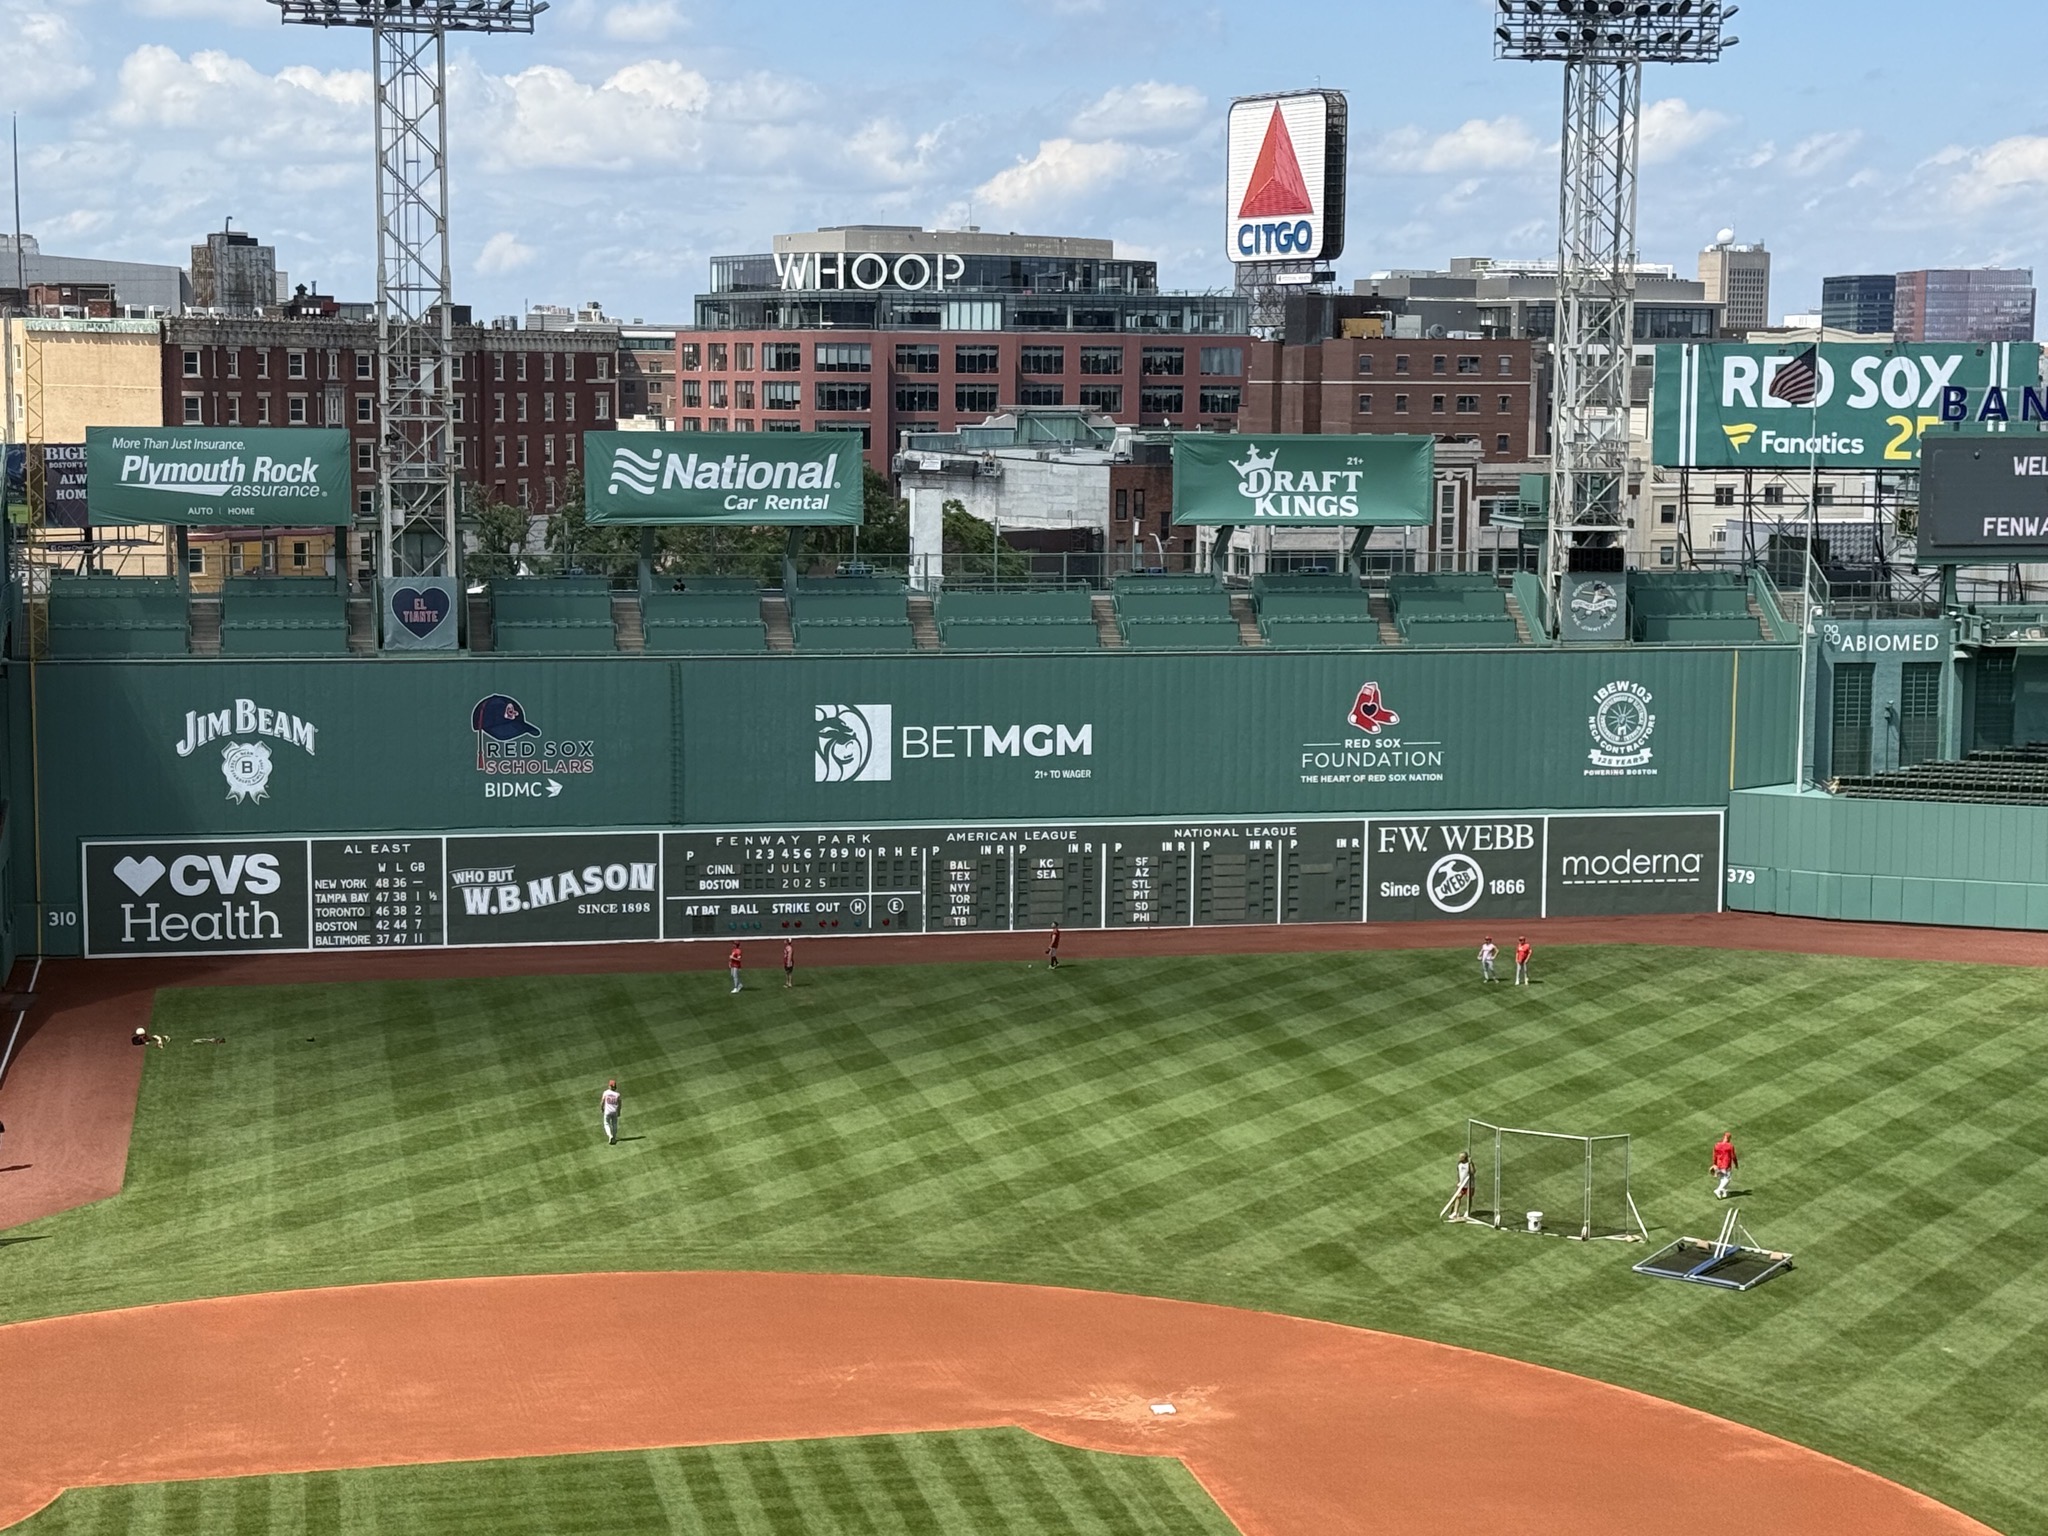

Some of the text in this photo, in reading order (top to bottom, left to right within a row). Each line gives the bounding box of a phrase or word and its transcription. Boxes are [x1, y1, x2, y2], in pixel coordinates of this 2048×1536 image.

[1238, 220, 1313, 255] CITGO
[773, 253, 965, 291] WHOOP
[1846, 355, 1963, 409] SOX
[112, 438, 246, 450] More Than Just Insurance.
[1761, 430, 1864, 455] Fanatics
[1346, 457, 1364, 465] 21+
[121, 455, 319, 485] Plymouth Rock
[662, 453, 838, 489] National
[1238, 469, 1363, 498] DRAFT
[231, 484, 320, 498] assurance
[723, 493, 829, 510] Car Rental
[1254, 493, 1359, 517] KINGS
[188, 507, 255, 516] AUTO HOME
[414, 598, 427, 610] EL
[403, 611, 439, 623] TIANTE
[1841, 634, 1939, 652] ABIOMED
[1593, 680, 1630, 704] IBEW
[1630, 683, 1653, 704] 103
[176, 698, 315, 757] JIM BEAM
[1600, 714, 1656, 754] CONTRACTORS
[902, 723, 1093, 759] BETMGM
[1344, 738, 1401, 748] RED SOX
[486, 740, 594, 758] RED SOX
[1302, 751, 1442, 768] FOUNDATION
[1615, 755, 1645, 765] YEARS
[241, 761, 253, 774] B
[486, 759, 594, 775] SCHOLARS
[1034, 769, 1092, 779] 21+ TO WAGER
[1300, 775, 1318, 783] THE
[1320, 775, 1351, 783] HEART
[1368, 774, 1386, 782] RED
[1388, 774, 1407, 782] SOX
[1409, 773, 1443, 781] NATION
[485, 782, 542, 797] BIDMC
[947, 831, 1077, 842] AMERICAN LEAGUE
[1174, 827, 1297, 838] NATIONAL LEAGUE
[1378, 824, 1534, 853] F.W. WEBB
[716, 834, 871, 846] FENWAY PARK
[344, 844, 411, 854] AL EAST
[932, 843, 1092, 856] P IN R P IN R
[1115, 842, 1185, 852] P IN R
[687, 847, 918, 861] P R H E
[378, 862, 425, 872] W L GB
[950, 860, 971, 870] BAL
[1039, 859, 1054, 868] KC
[1135, 857, 1149, 866] SF
[1562, 848, 1700, 876] moderna
[169, 853, 281, 896] CVS
[452, 869, 515, 884] WHO BUT
[950, 871, 971, 881] TEX
[1036, 870, 1057, 879] SEA
[1135, 868, 1149, 877] AZ
[1727, 869, 1755, 884] 379
[315, 878, 407, 889] NEW YORK 48 36
[700, 879, 740, 890] BOSTON
[950, 884, 971, 893] NYY
[1132, 880, 1151, 889] STL
[1380, 879, 1526, 897] Since 1866
[1440, 872, 1471, 895] WEBB
[315, 893, 347, 903] TAMPA
[351, 893, 369, 903] BAY
[376, 892, 390, 902] 47
[393, 892, 407, 901] 38
[950, 894, 971, 904] TOR
[1133, 891, 1150, 900] PIT
[315, 905, 422, 917] TORONTO 46 38 2
[578, 902, 651, 914] SINCE 1898
[686, 906, 699, 916] AT
[702, 905, 720, 915] BAT
[731, 904, 759, 914] BALL
[772, 903, 810, 914] STRIKE
[816, 902, 840, 913] OUT
[950, 906, 970, 915] ATH
[1135, 902, 1149, 911] SD
[48, 911, 77, 927] 310
[121, 901, 283, 942] Health
[953, 917, 967, 926] TB
[1133, 913, 1150, 922] PHI
[315, 919, 421, 932] BOSTON 42 44 7
[315, 935, 371, 946] BALTIMORE
[376, 934, 390, 944] 37
[394, 934, 407, 944] 47
